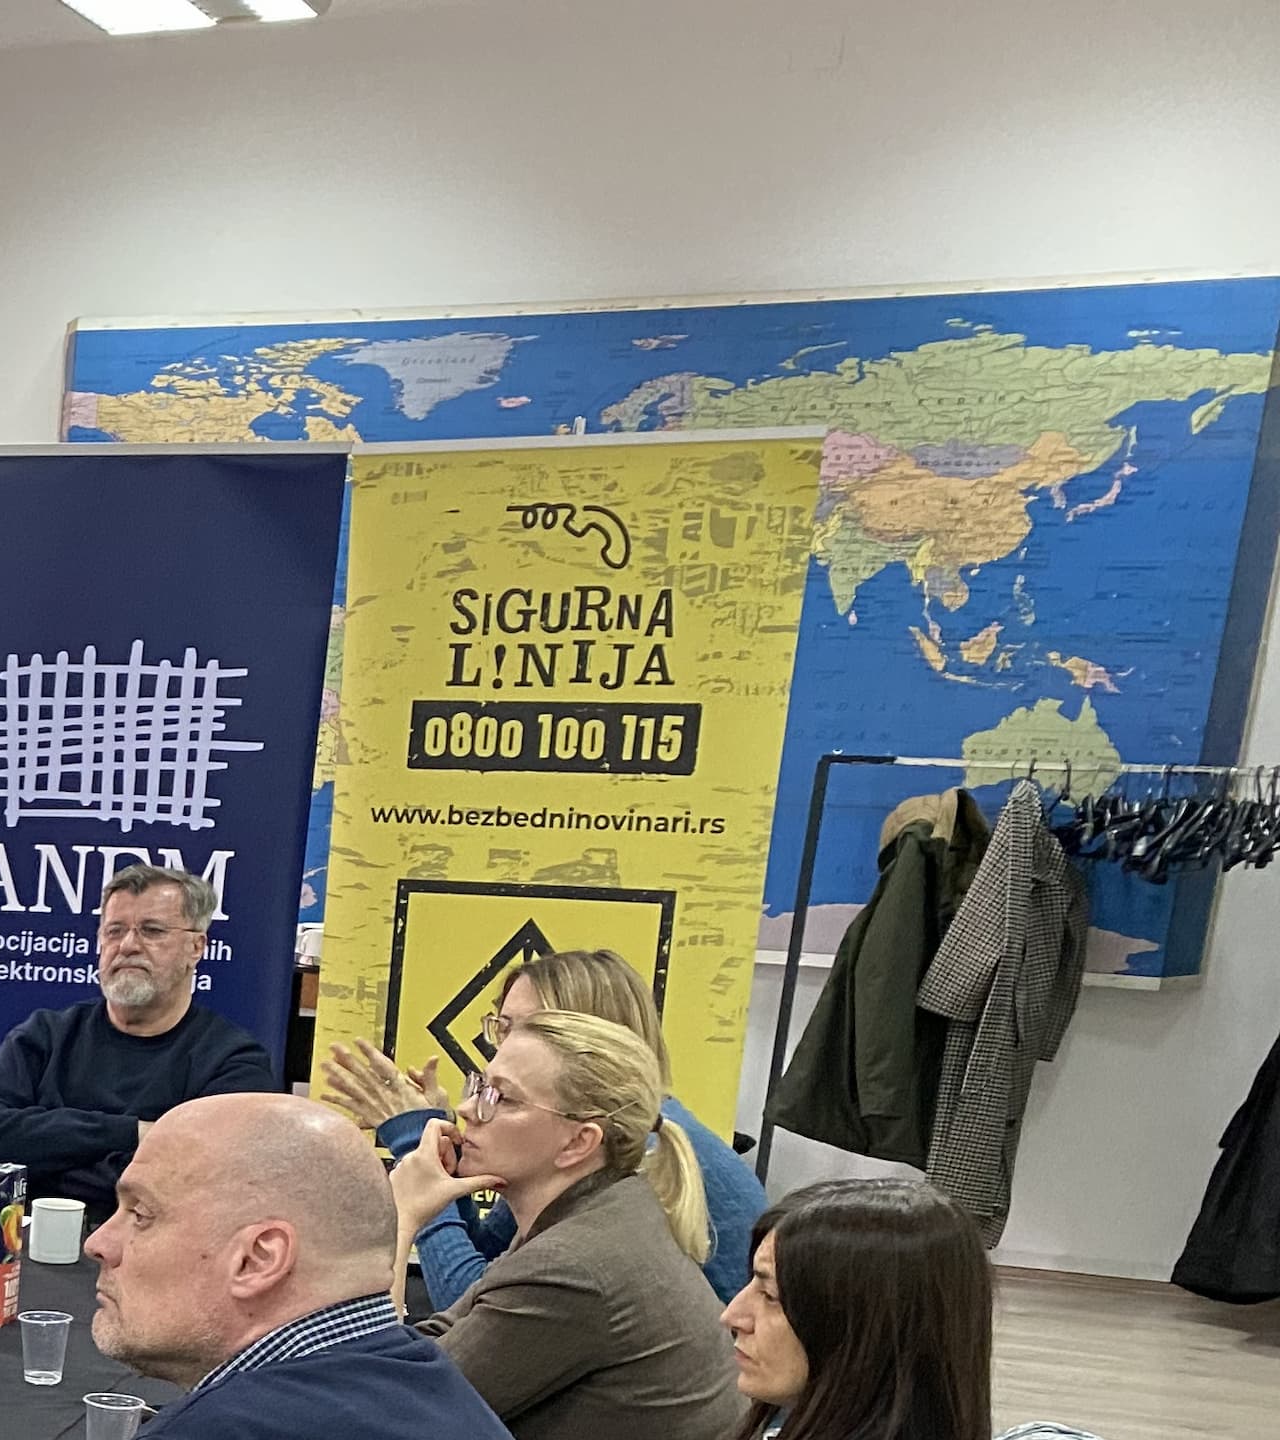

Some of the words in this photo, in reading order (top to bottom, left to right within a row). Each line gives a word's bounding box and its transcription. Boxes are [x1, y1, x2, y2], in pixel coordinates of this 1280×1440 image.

[449, 585, 675, 638] SIGURNA
[445, 640, 676, 690] L!NIJA
[424, 711, 524, 759] 0800
[537, 713, 606, 760] 100
[621, 714, 686, 762] 115
[370, 804, 726, 835] www.bezbedninovinari.rs
